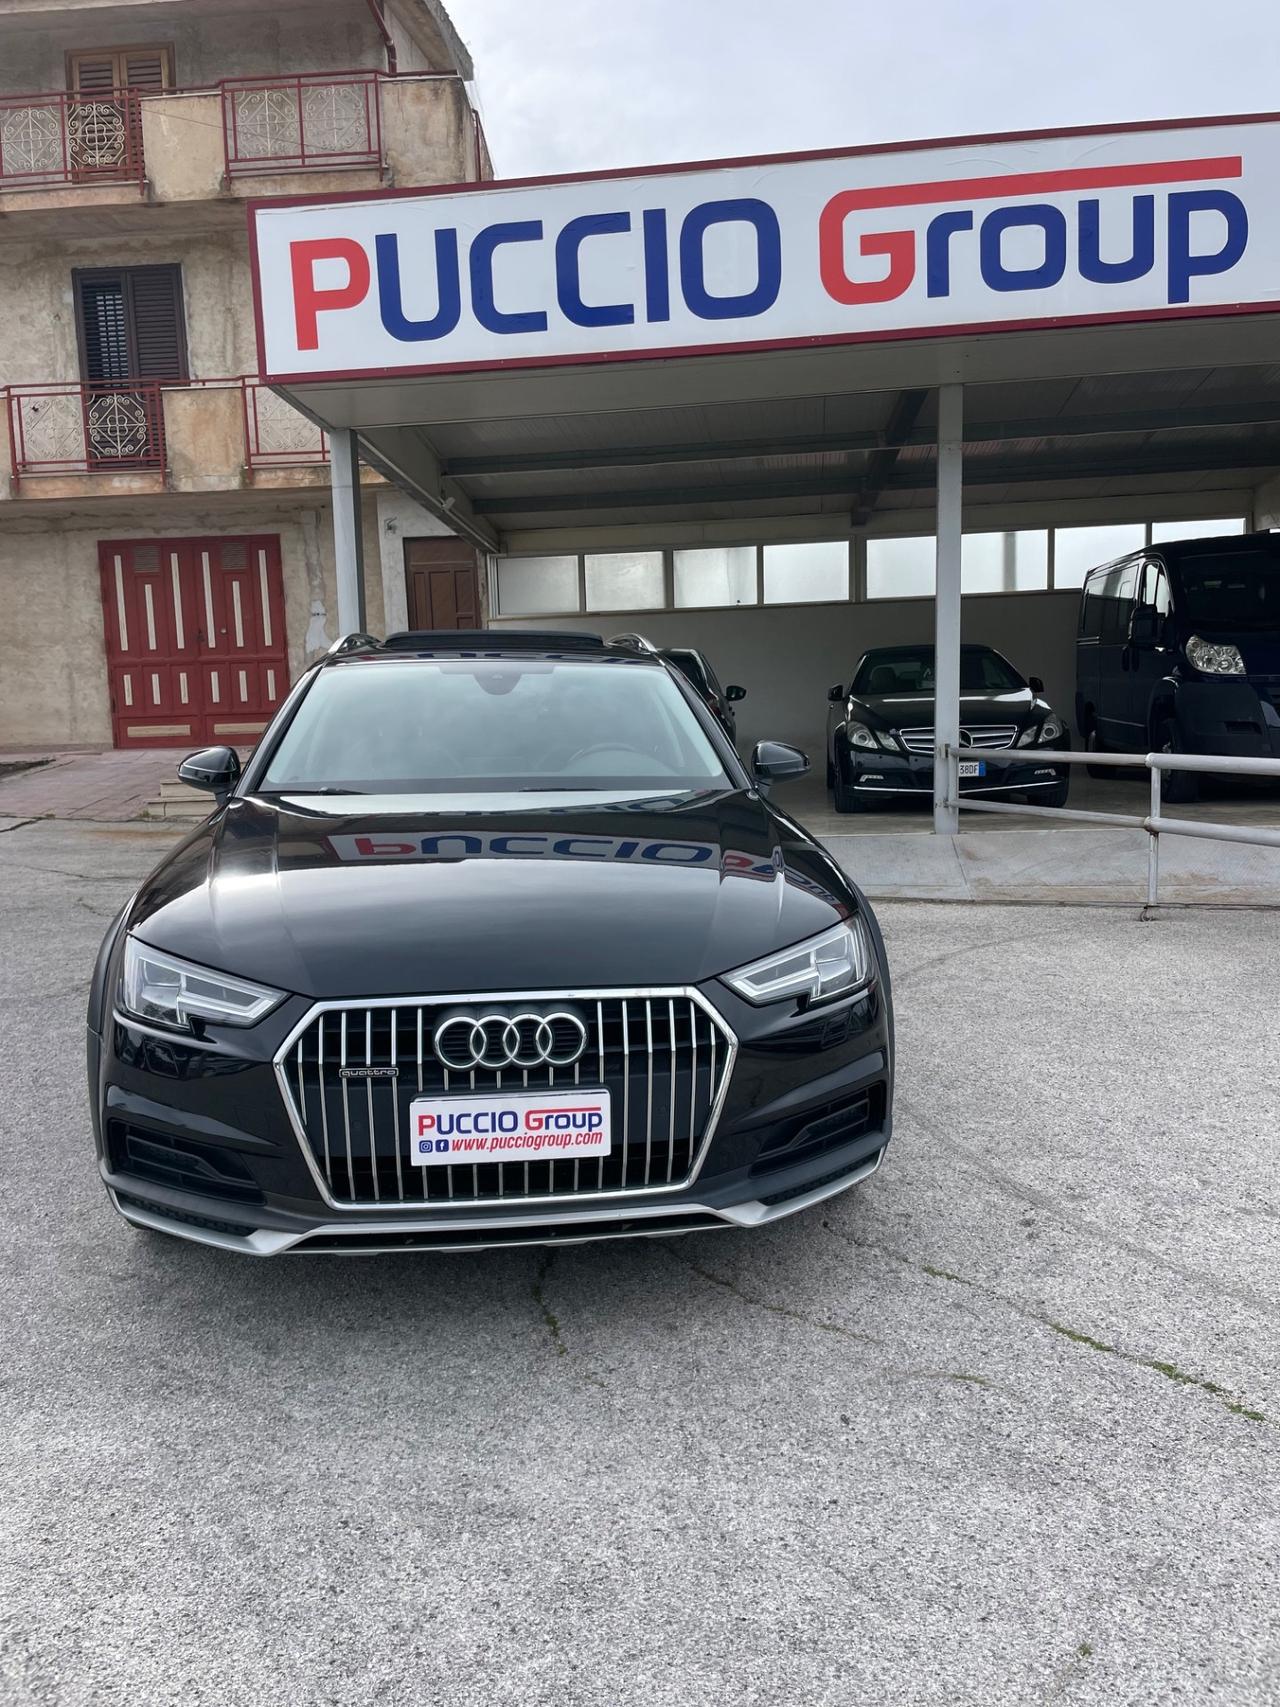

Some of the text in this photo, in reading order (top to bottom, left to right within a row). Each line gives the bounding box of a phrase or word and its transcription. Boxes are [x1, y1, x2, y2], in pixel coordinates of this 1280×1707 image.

[289, 156, 1249, 351] PUCCIO Group
[341, 1069, 397, 1078] quattro
[418, 1107, 603, 1136] PUCCIO Group
[451, 1131, 603, 1152] www.pucciogroup.com
